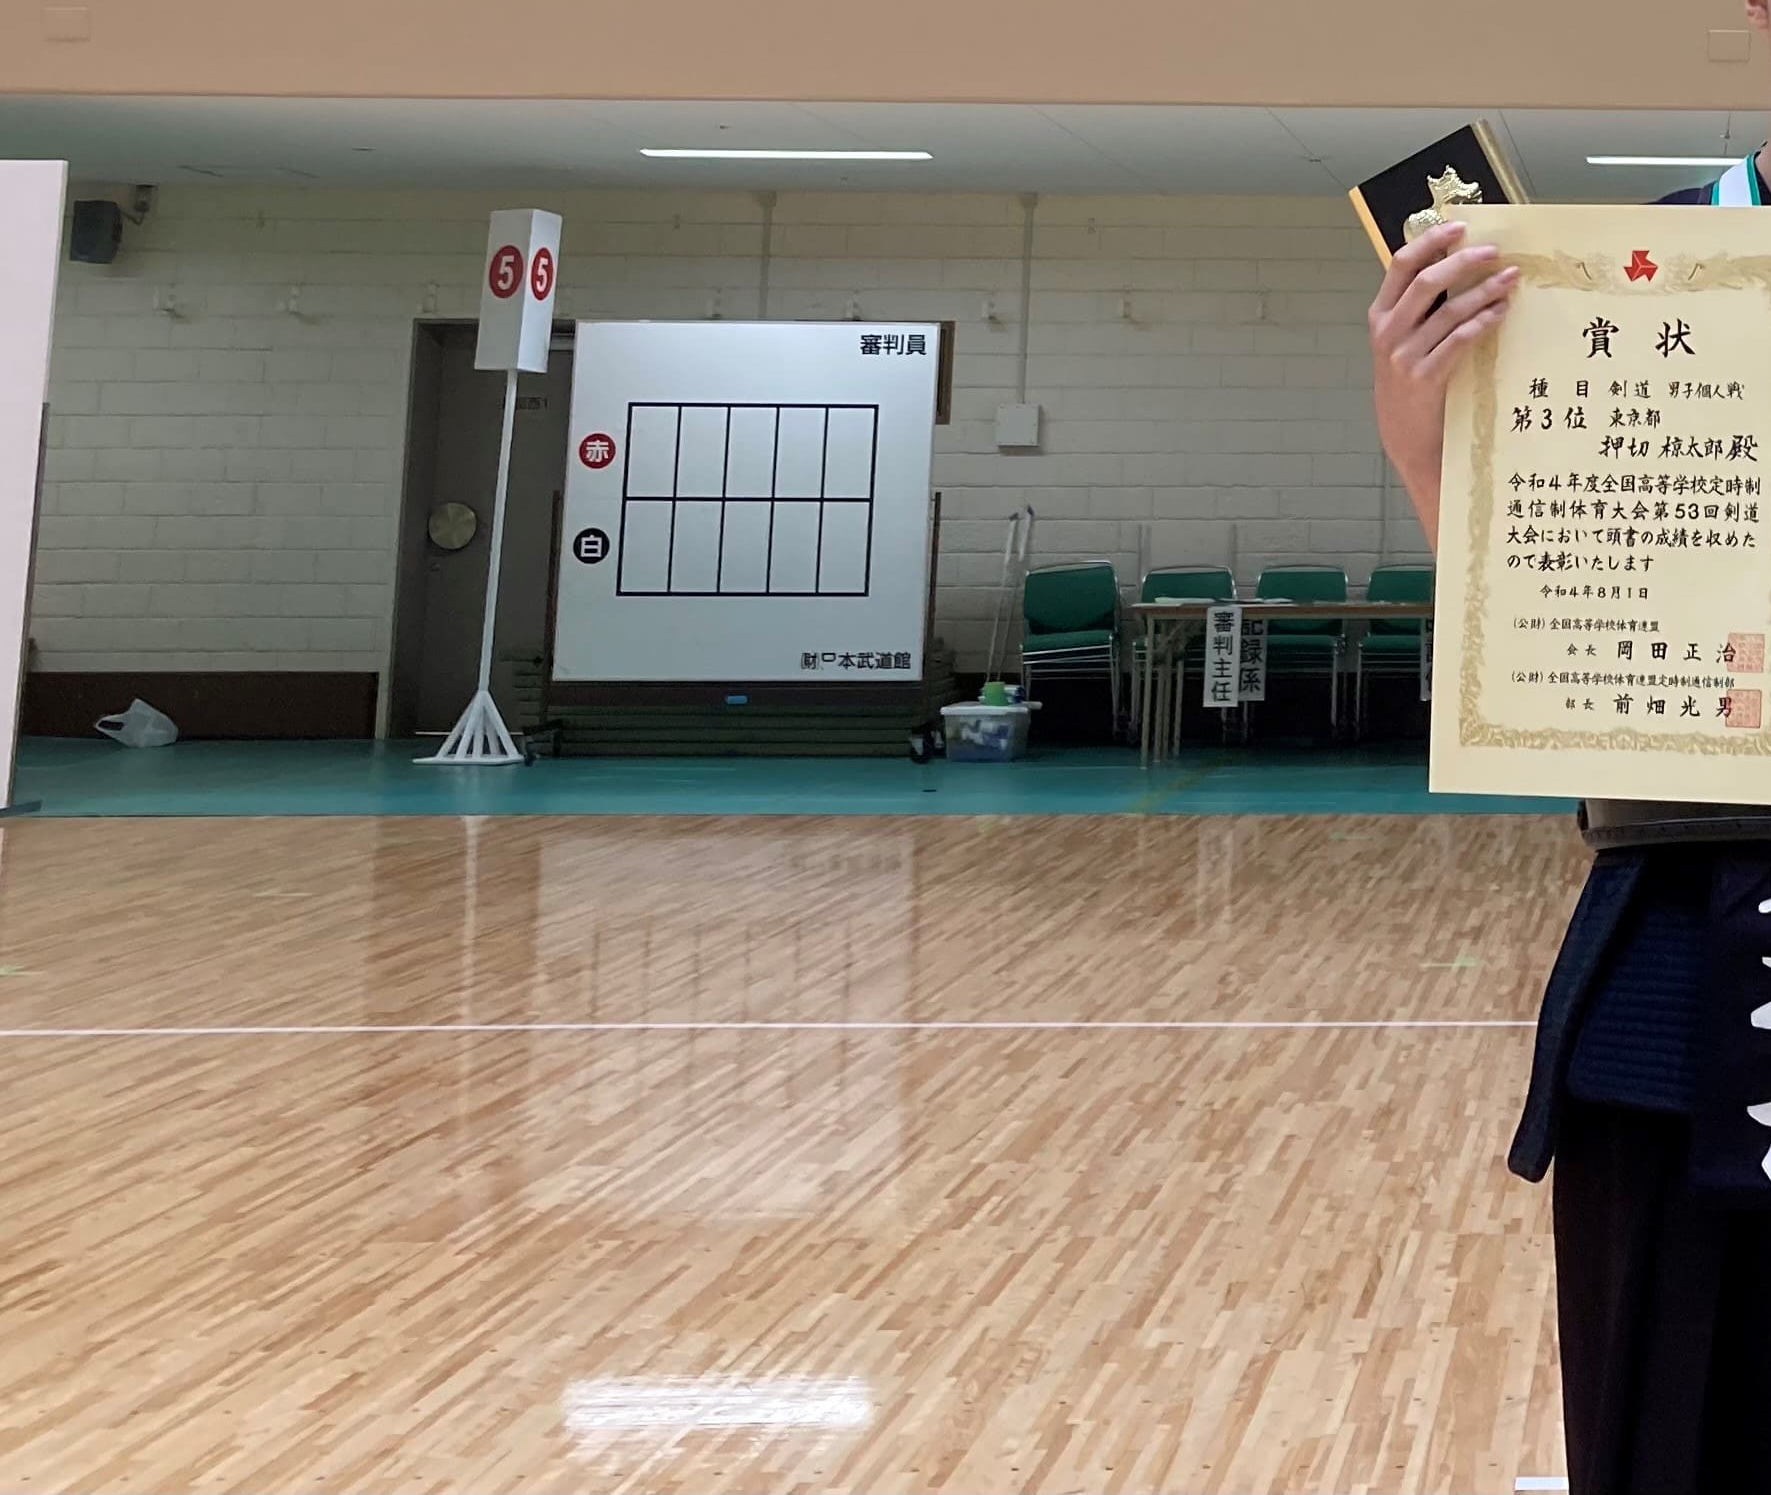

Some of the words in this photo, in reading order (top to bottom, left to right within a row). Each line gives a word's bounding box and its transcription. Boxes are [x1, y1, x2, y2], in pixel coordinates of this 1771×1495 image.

[497, 256, 514, 290] 5
[534, 256, 548, 292] 5
[858, 332, 928, 357] 審判員
[1582, 317, 1695, 359] 賞状
[1529, 377, 1589, 399] 種目
[1609, 380, 1652, 399] 剣道
[1668, 380, 1745, 400] 男子個人戦
[1511, 406, 1587, 433] 第3位
[1609, 407, 1661, 429] 東京都
[587, 439, 610, 463] 赤
[1598, 435, 1649, 459] 押切
[1507, 471, 1761, 497] 令和4年度全国高等学校定時制
[1506, 498, 1760, 524] 通信制体育大会第53回剣道
[581, 535, 603, 560] 白
[1505, 524, 1757, 549] 大会において頭書の成績を収めた
[1506, 550, 1655, 572] ので表彰いたします
[1539, 583, 1649, 600] 令和4年8月1日
[1211, 610, 1236, 703] 審判主任
[1566, 642, 1597, 658] 会長
[1616, 639, 1738, 664] 岡田正治
[1565, 697, 1595, 711] 部長
[1613, 693, 1733, 719] 前畑光男
